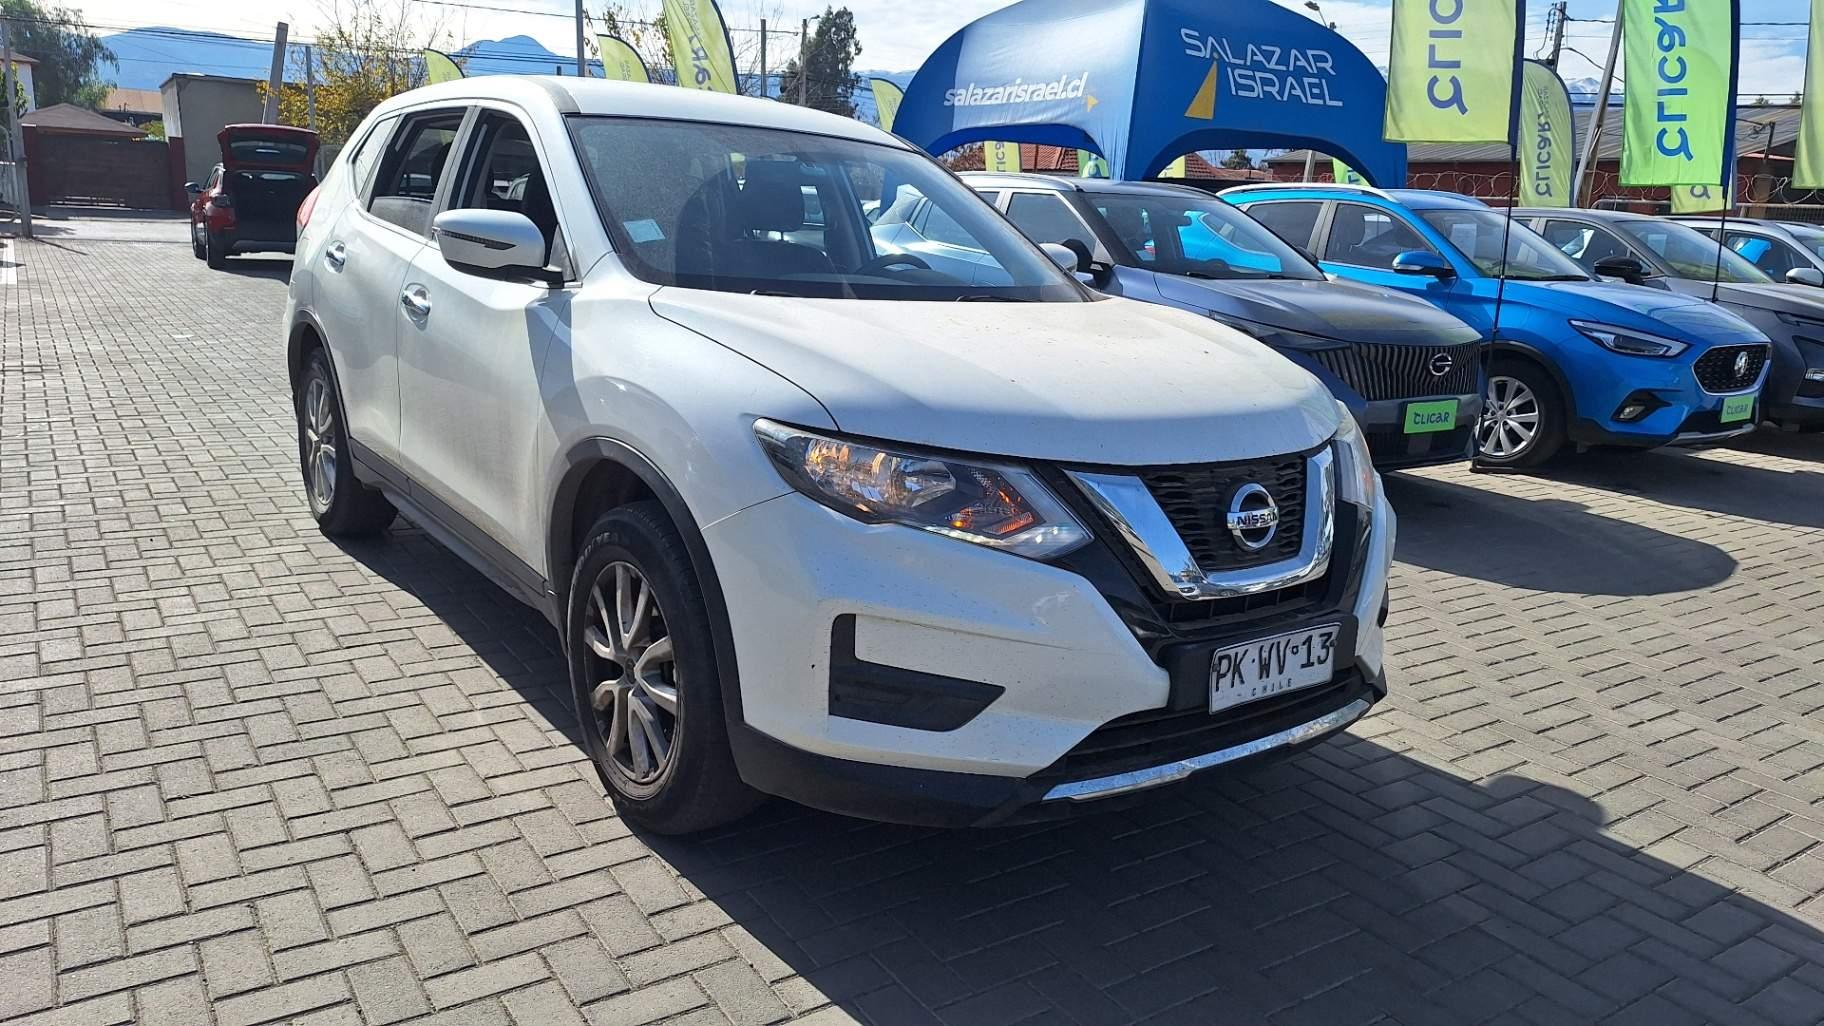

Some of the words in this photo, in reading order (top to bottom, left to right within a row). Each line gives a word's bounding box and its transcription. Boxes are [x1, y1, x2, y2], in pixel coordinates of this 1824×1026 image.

[1180, 27, 1337, 77] SALAZAR
[943, 71, 1089, 107] salazarisrael.cl
[1227, 68, 1344, 108] ISRAEL
[1237, 511, 1278, 526] NISSAN
[1251, 678, 1292, 697] CHILE
